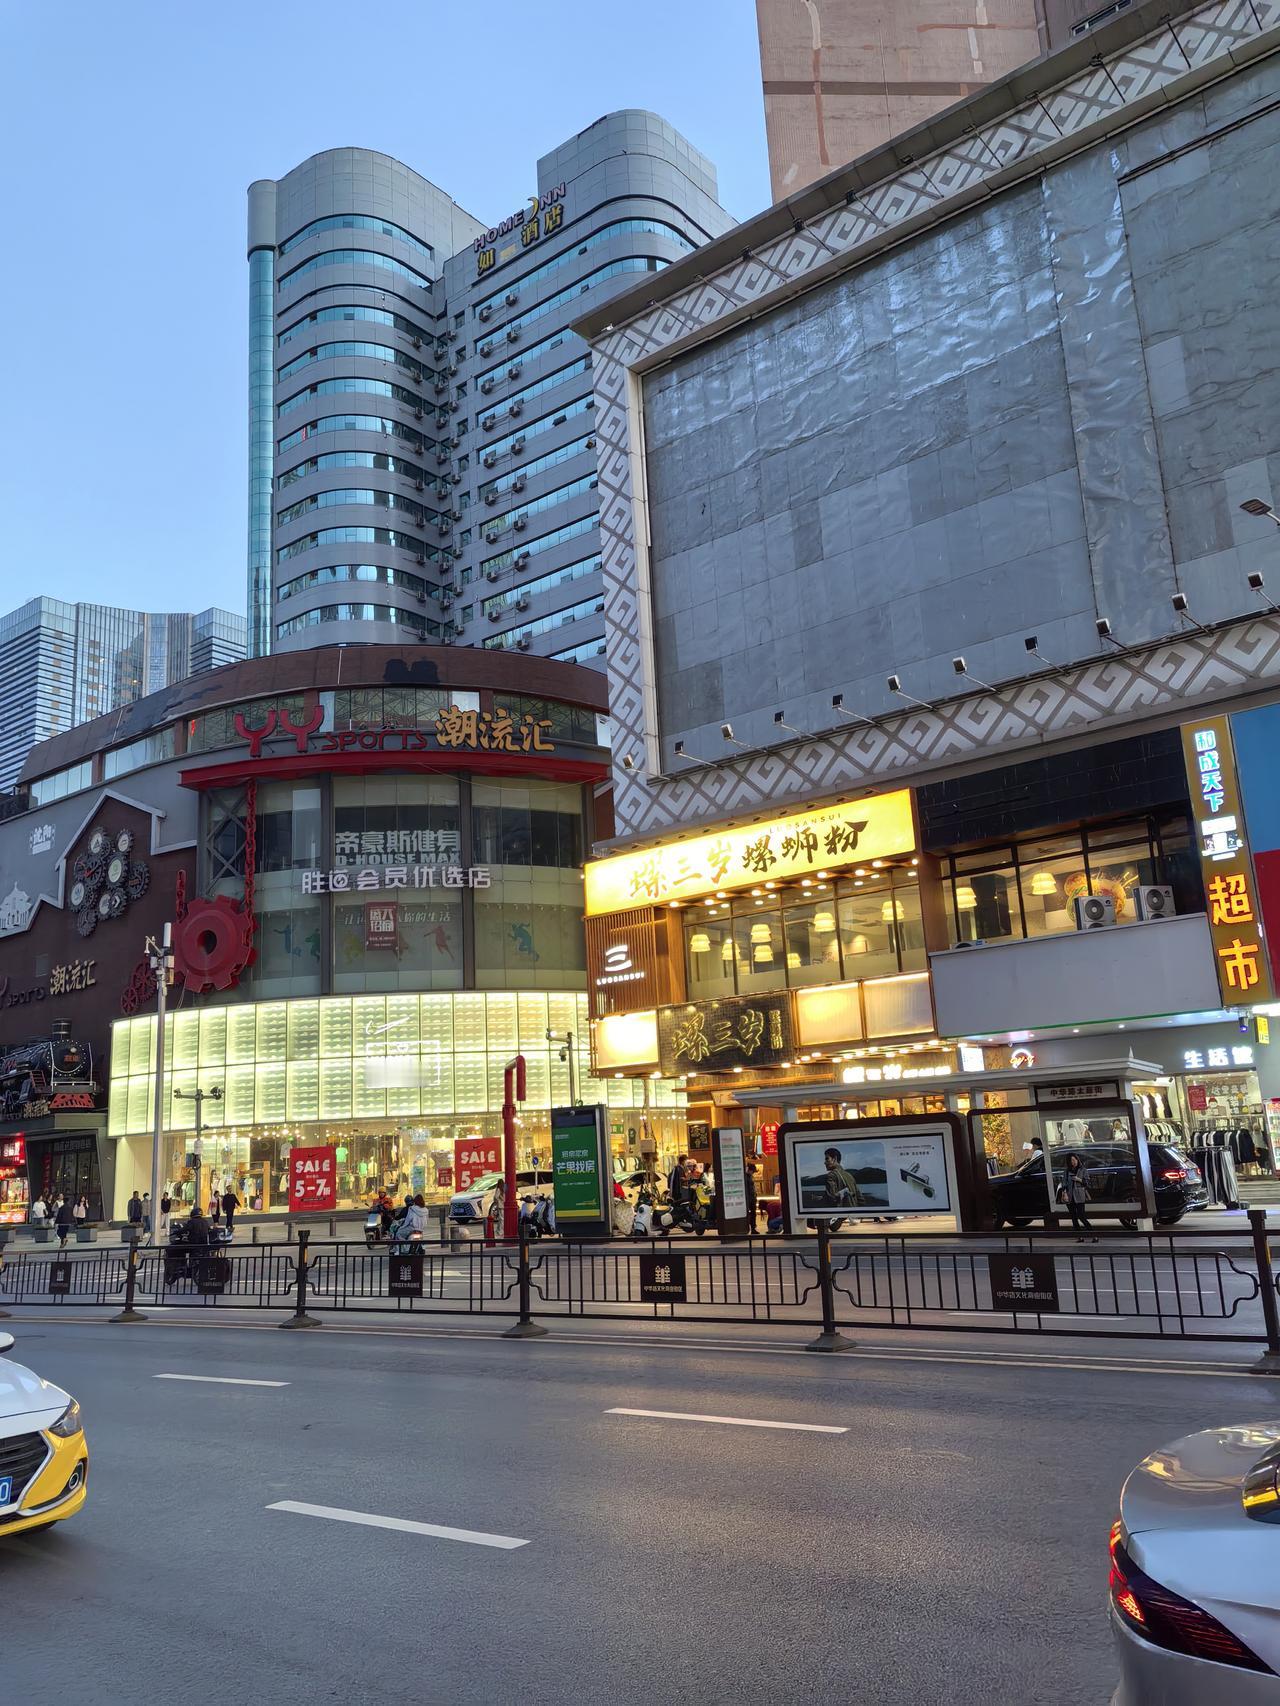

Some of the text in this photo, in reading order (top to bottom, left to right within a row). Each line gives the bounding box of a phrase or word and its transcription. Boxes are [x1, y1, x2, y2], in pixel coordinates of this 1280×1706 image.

[474, 209, 525, 252] HOME
[478, 204, 564, 276] 如酒店
[436, 704, 555, 751] 潮流汇
[1194, 730, 1225, 813] 和成天下
[335, 829, 460, 854] 帝豪斯健身
[420, 852, 460, 866] MAX
[302, 865, 491, 895] 胜道会员优选店
[1208, 873, 1260, 991] 超市
[49, 959, 96, 995] 潮流汇
[295, 1160, 331, 1174] SALE
[461, 1150, 496, 1165] SALE
